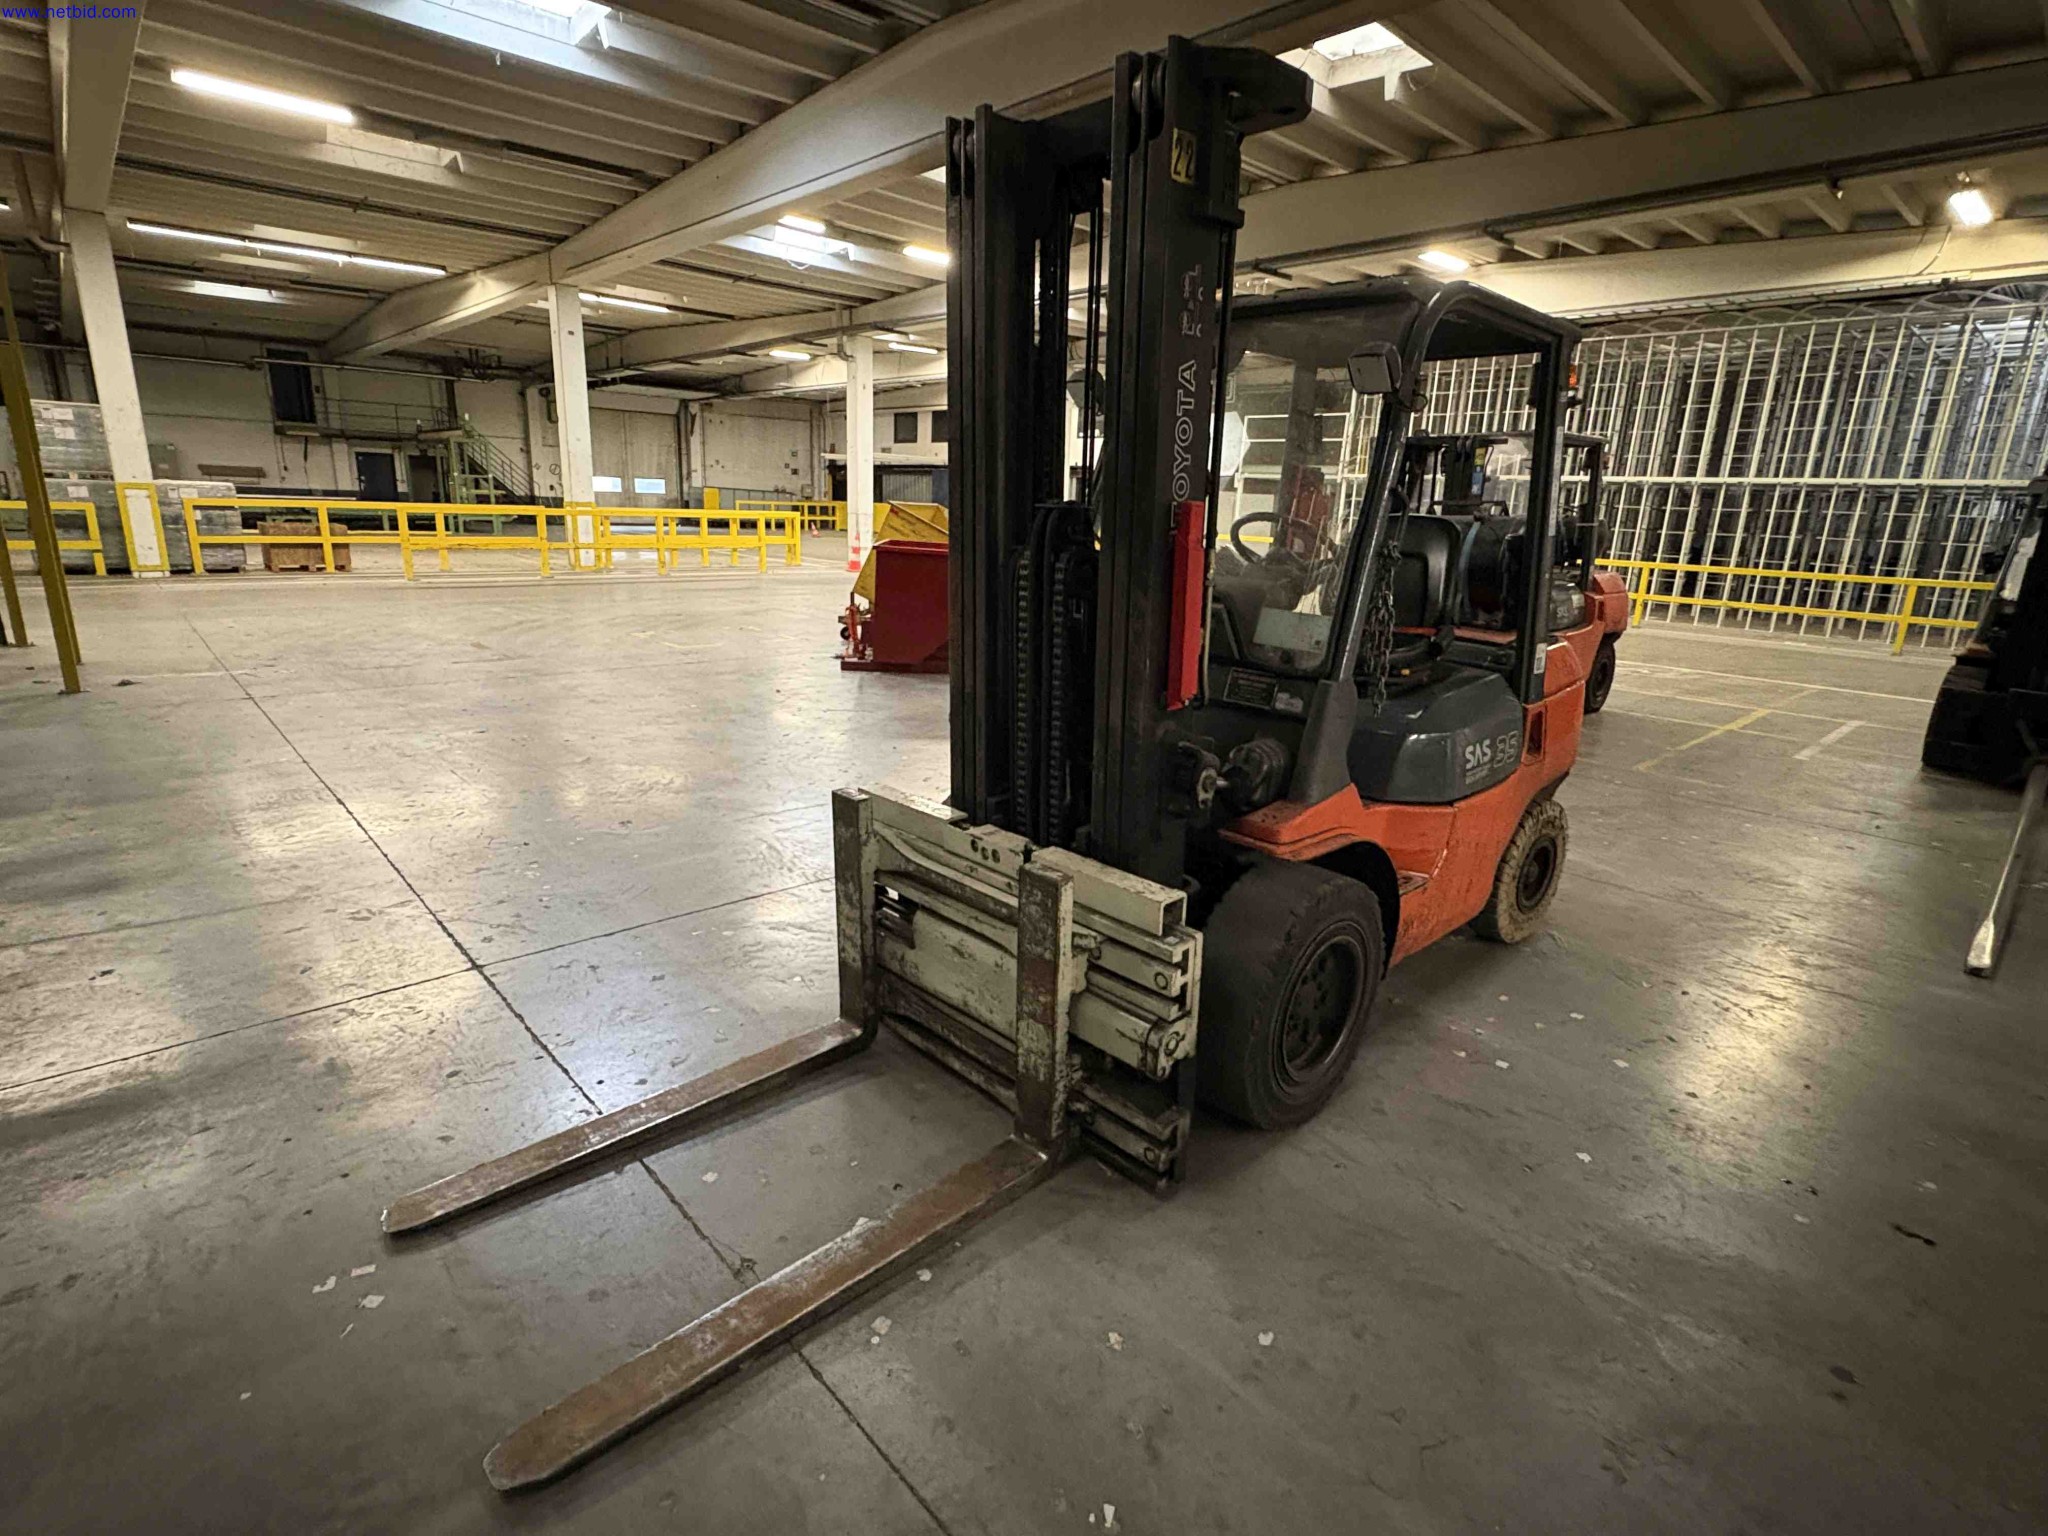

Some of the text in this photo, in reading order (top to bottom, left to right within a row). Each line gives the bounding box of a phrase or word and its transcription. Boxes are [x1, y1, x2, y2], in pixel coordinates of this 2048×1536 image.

[1173, 135, 1193, 179] 22
[1171, 360, 1196, 527] OYOTA
[1465, 739, 1491, 769] SAS
